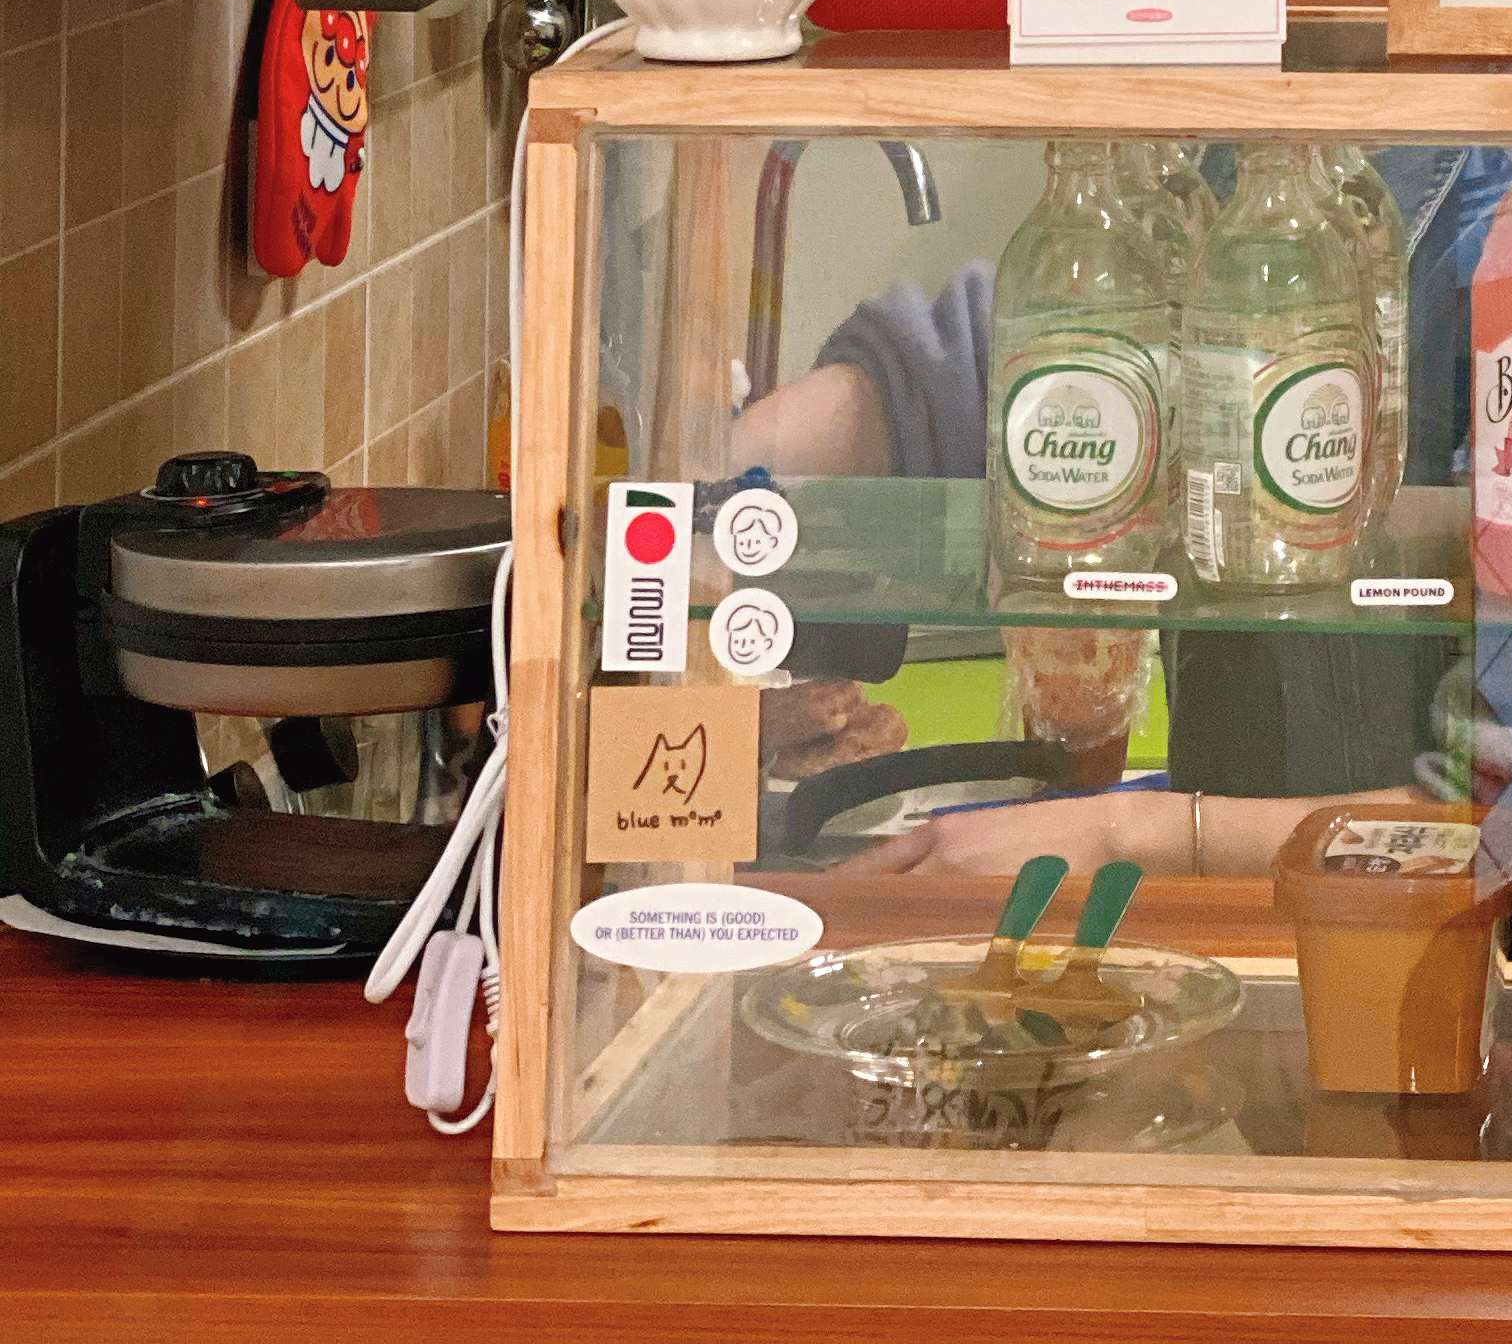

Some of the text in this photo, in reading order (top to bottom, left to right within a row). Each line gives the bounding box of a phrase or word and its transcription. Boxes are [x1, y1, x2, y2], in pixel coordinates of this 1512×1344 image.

[1024, 429, 1117, 466] Chang
[1285, 433, 1357, 462] Chang
[1359, 587, 1445, 598] LEMON POUND
[617, 810, 660, 830] blue
[629, 911, 765, 925] SOMETHING IS (GOOD)
[595, 927, 799, 941] OR (BETTER THAN) YOU EXPECTED
